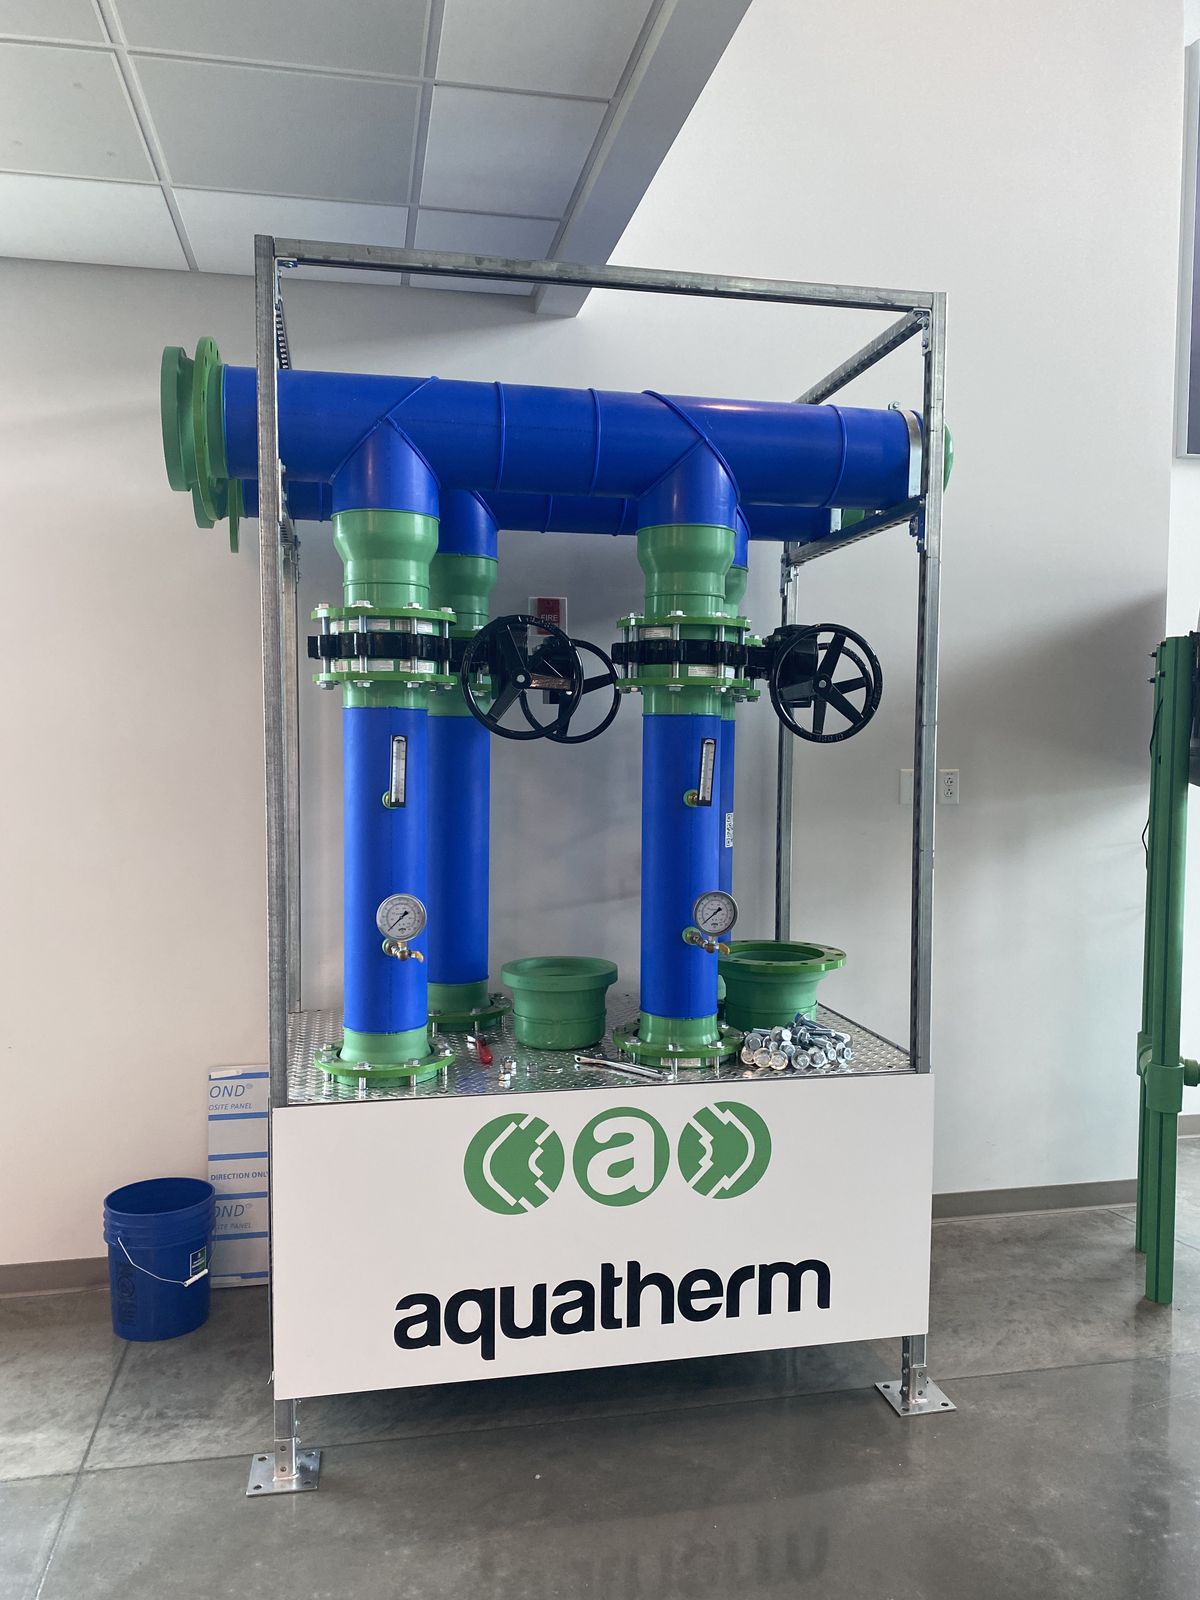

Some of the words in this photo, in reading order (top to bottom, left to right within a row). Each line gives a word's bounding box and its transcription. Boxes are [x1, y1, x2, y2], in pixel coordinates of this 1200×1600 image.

[540, 614, 558, 622] FIRE
[210, 1172, 249, 1181] DIRECTION
[394, 1259, 831, 1361] aquatherm
